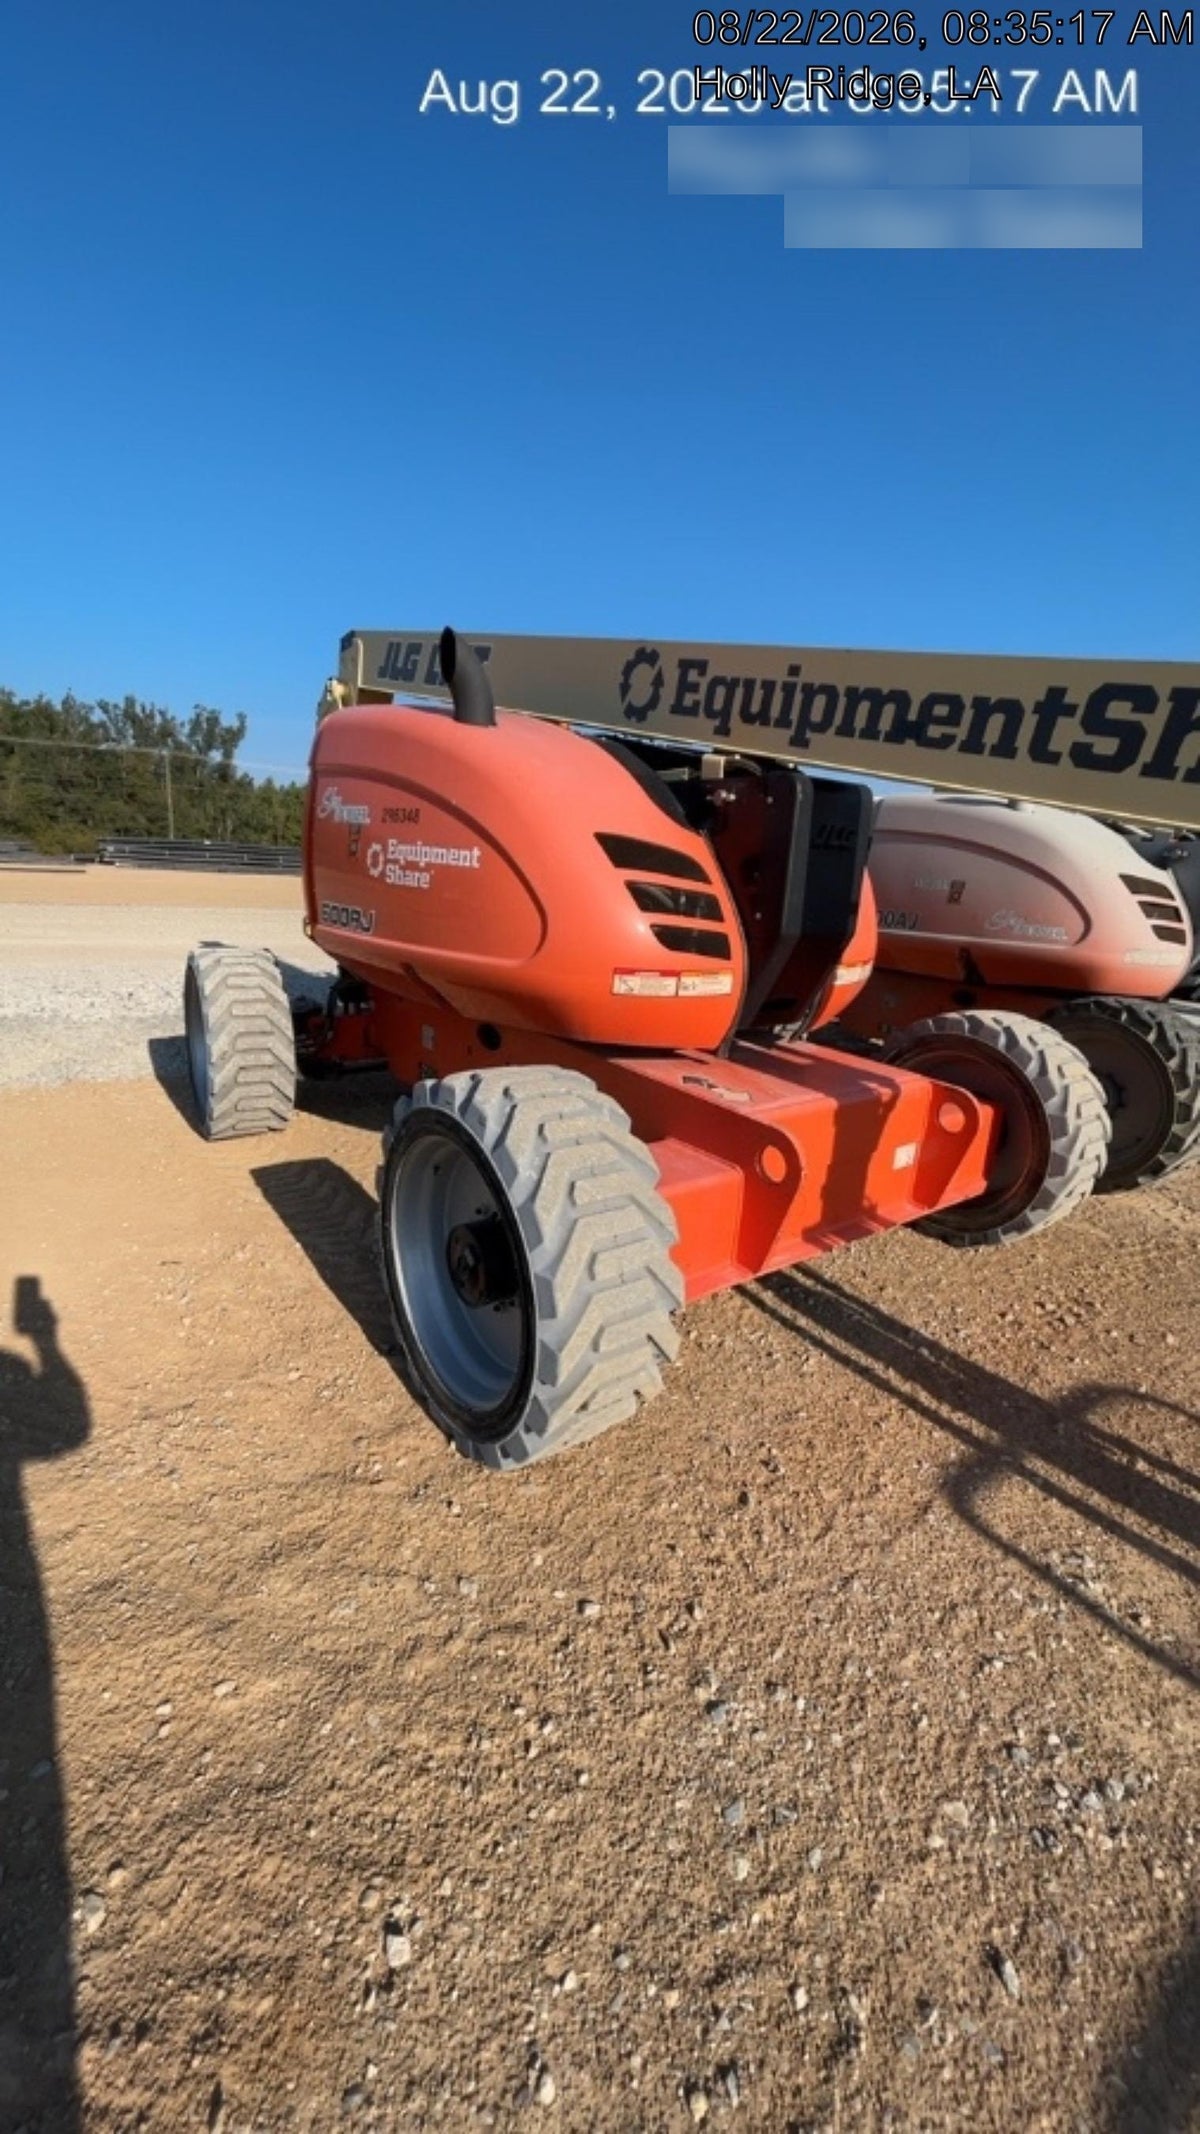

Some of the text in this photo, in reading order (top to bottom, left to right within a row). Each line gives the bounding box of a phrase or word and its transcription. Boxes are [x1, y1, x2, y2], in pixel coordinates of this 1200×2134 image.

[377, 642, 422, 682] JLG
[386, 838, 481, 868] Equipment
[386, 864, 431, 888] Share
